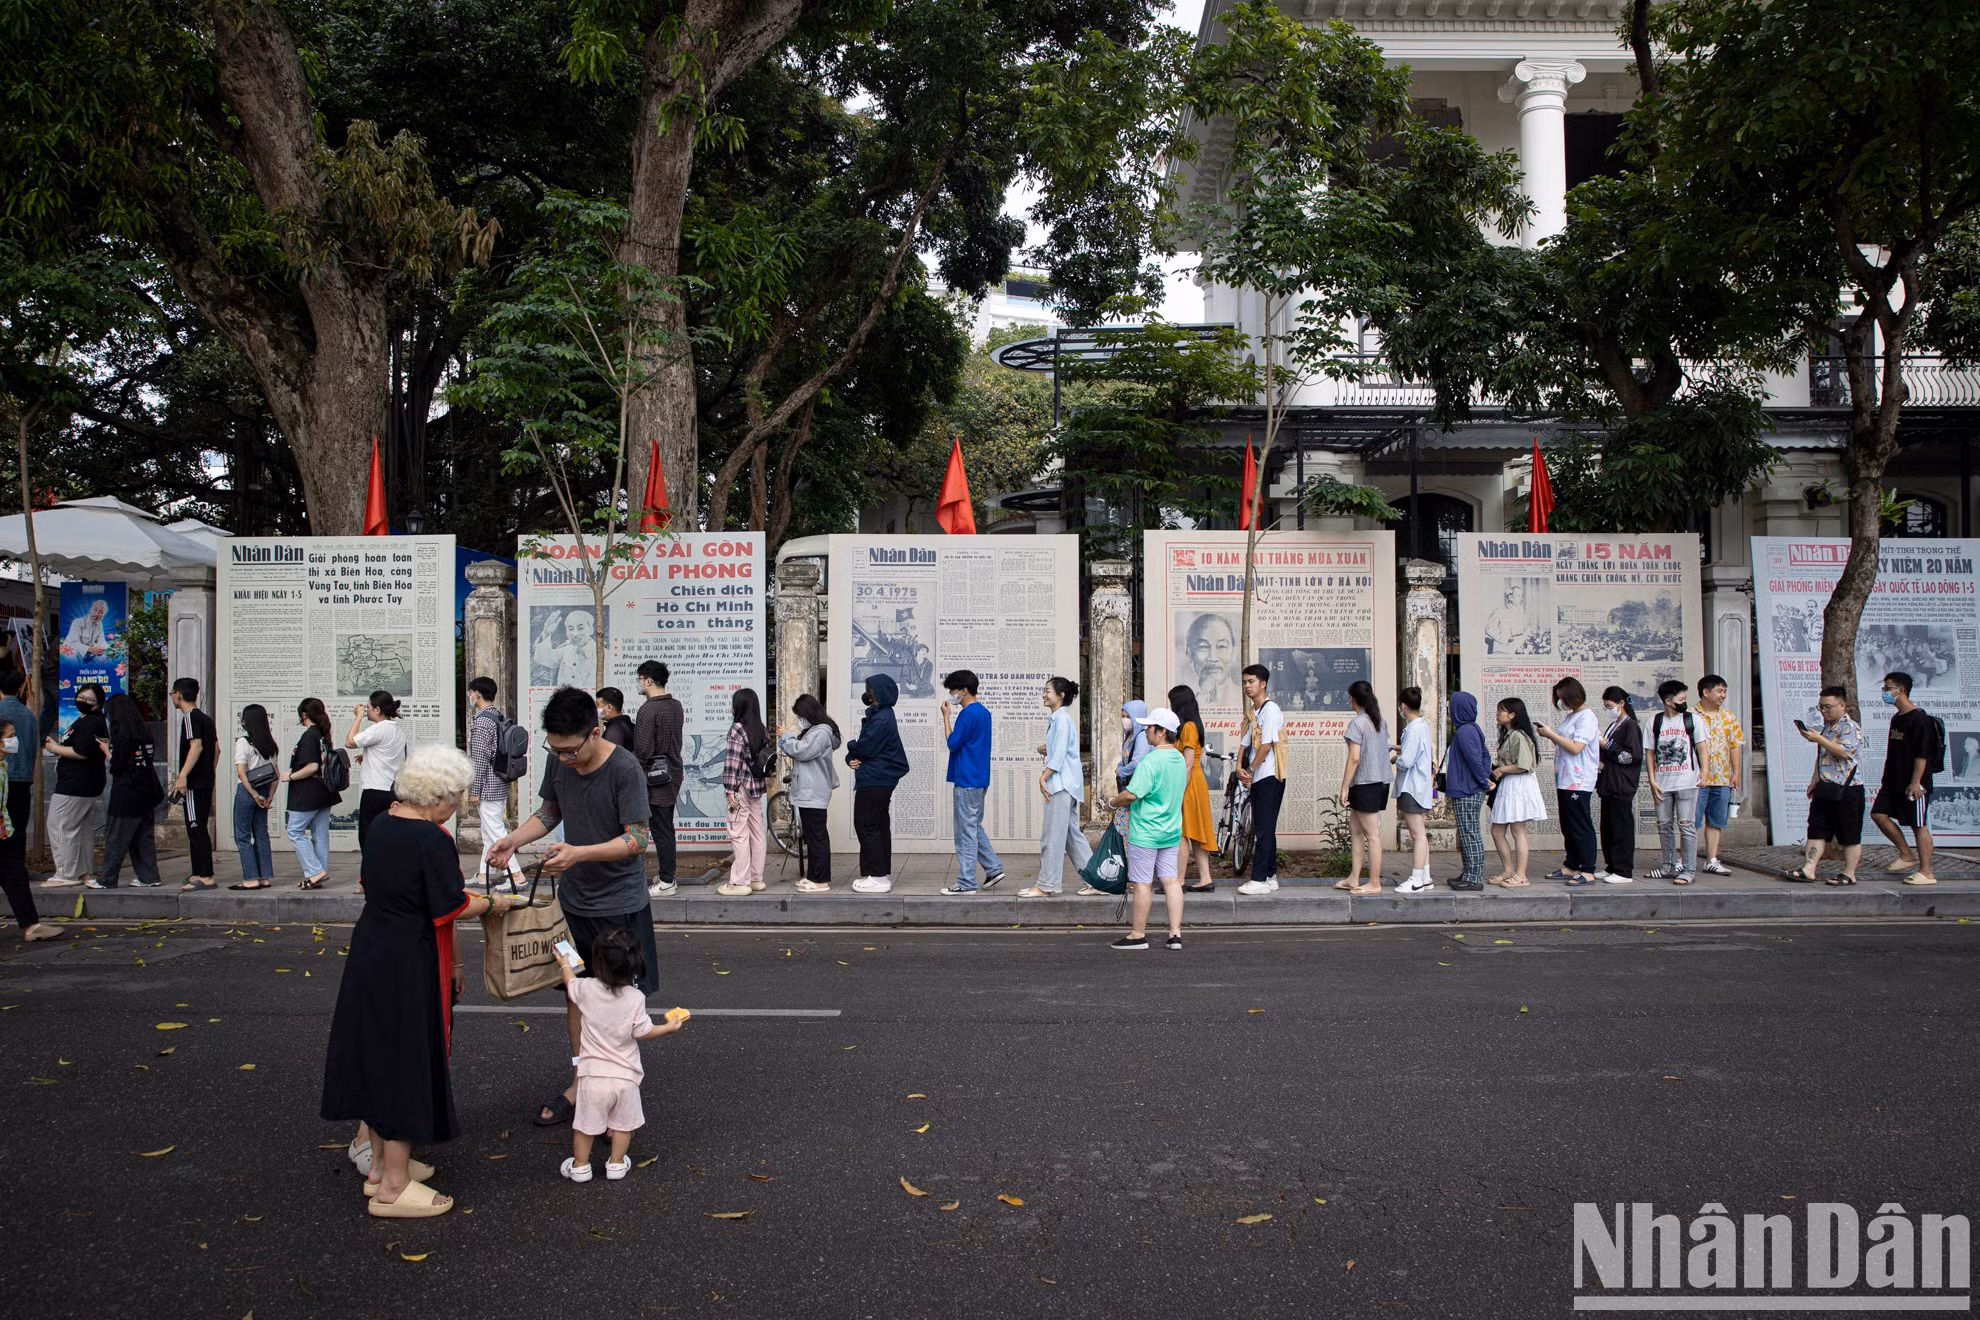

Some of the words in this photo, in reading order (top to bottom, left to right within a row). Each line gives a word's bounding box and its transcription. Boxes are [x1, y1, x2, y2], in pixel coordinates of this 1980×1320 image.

[232, 544, 271, 562] Nhân
[274, 544, 304, 562] Dân
[655, 541, 692, 558] SÀI
[703, 540, 753, 557] GÒN
[870, 548, 906, 562] Nhân
[910, 548, 936, 562] Dân
[1478, 541, 1518, 558] Nhân
[1522, 541, 1552, 558] Dân
[1586, 543, 1612, 560] 15
[1618, 542, 1672, 560] NĂM
[1790, 545, 1832, 561] Nhân
[309, 553, 326, 564] Giải
[332, 553, 359, 564] phóng
[365, 553, 386, 562] hoàn
[393, 553, 412, 562] toàn
[1891, 556, 1923, 574] NIỆM
[1926, 559, 1942, 573] 20
[1945, 556, 1973, 573] NĂM
[309, 567, 319, 577] thị
[325, 568, 336, 577] xã
[341, 567, 360, 577] Biên
[365, 567, 385, 577] Hòa,
[391, 567, 412, 577] cảng
[610, 561, 658, 580] GIẢI
[668, 561, 752, 580] PHÓNG
[1187, 574, 1224, 591] Nhân
[1257, 576, 1301, 587] MÍT-TINH
[1305, 576, 1322, 587] LỚN
[1327, 576, 1333, 587] Ở
[1339, 576, 1351, 587] HÀ
[1356, 576, 1371, 587] NỘI
[1871, 578, 1886, 593] GÀY
[1890, 578, 1910, 593] QUỐC
[1912, 578, 1921, 593] TẾ
[1922, 582, 1936, 593] LAO
[1938, 579, 1960, 595] ĐỘNG
[1962, 582, 1974, 593] 1-5
[291, 589, 302, 600] 1-5
[670, 585, 716, 596] Chiến
[721, 585, 753, 596] dịch
[319, 594, 329, 604] và
[333, 594, 349, 604] tỉnh
[353, 594, 383, 604] Phước
[387, 594, 402, 605] Tuy
[656, 601, 679, 612] Hồ
[686, 601, 710, 612] Chí
[717, 601, 753, 612] Minh
[657, 618, 695, 629] toàn
[708, 616, 753, 630] thắng
[511, 941, 538, 960] HELLO
